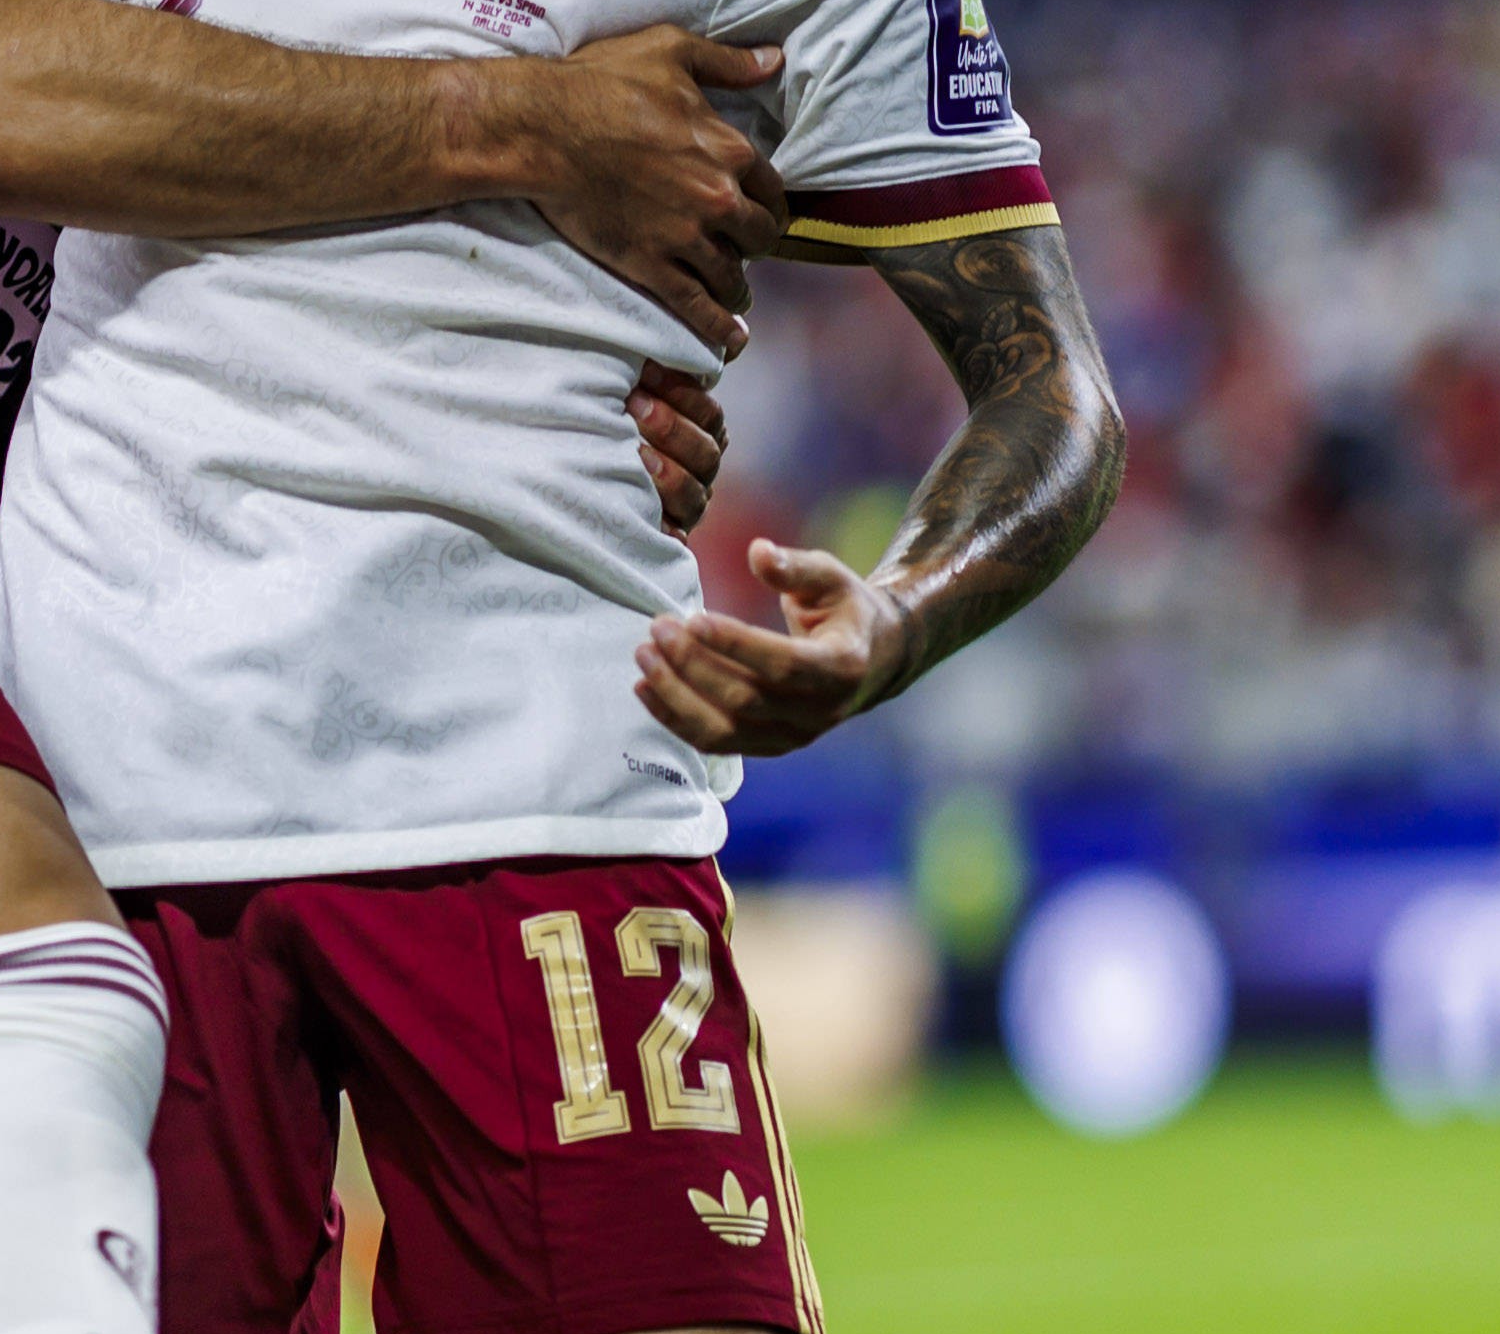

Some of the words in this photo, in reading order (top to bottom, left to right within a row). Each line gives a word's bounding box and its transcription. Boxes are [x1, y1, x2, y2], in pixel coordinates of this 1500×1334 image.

[462, 0, 475, 11] 14
[476, 1, 502, 18] JULY
[504, 9, 532, 27] 2026
[472, 15, 513, 37] DALLAS
[975, 99, 1000, 115] FIFA
[520, 906, 742, 1145] 12
